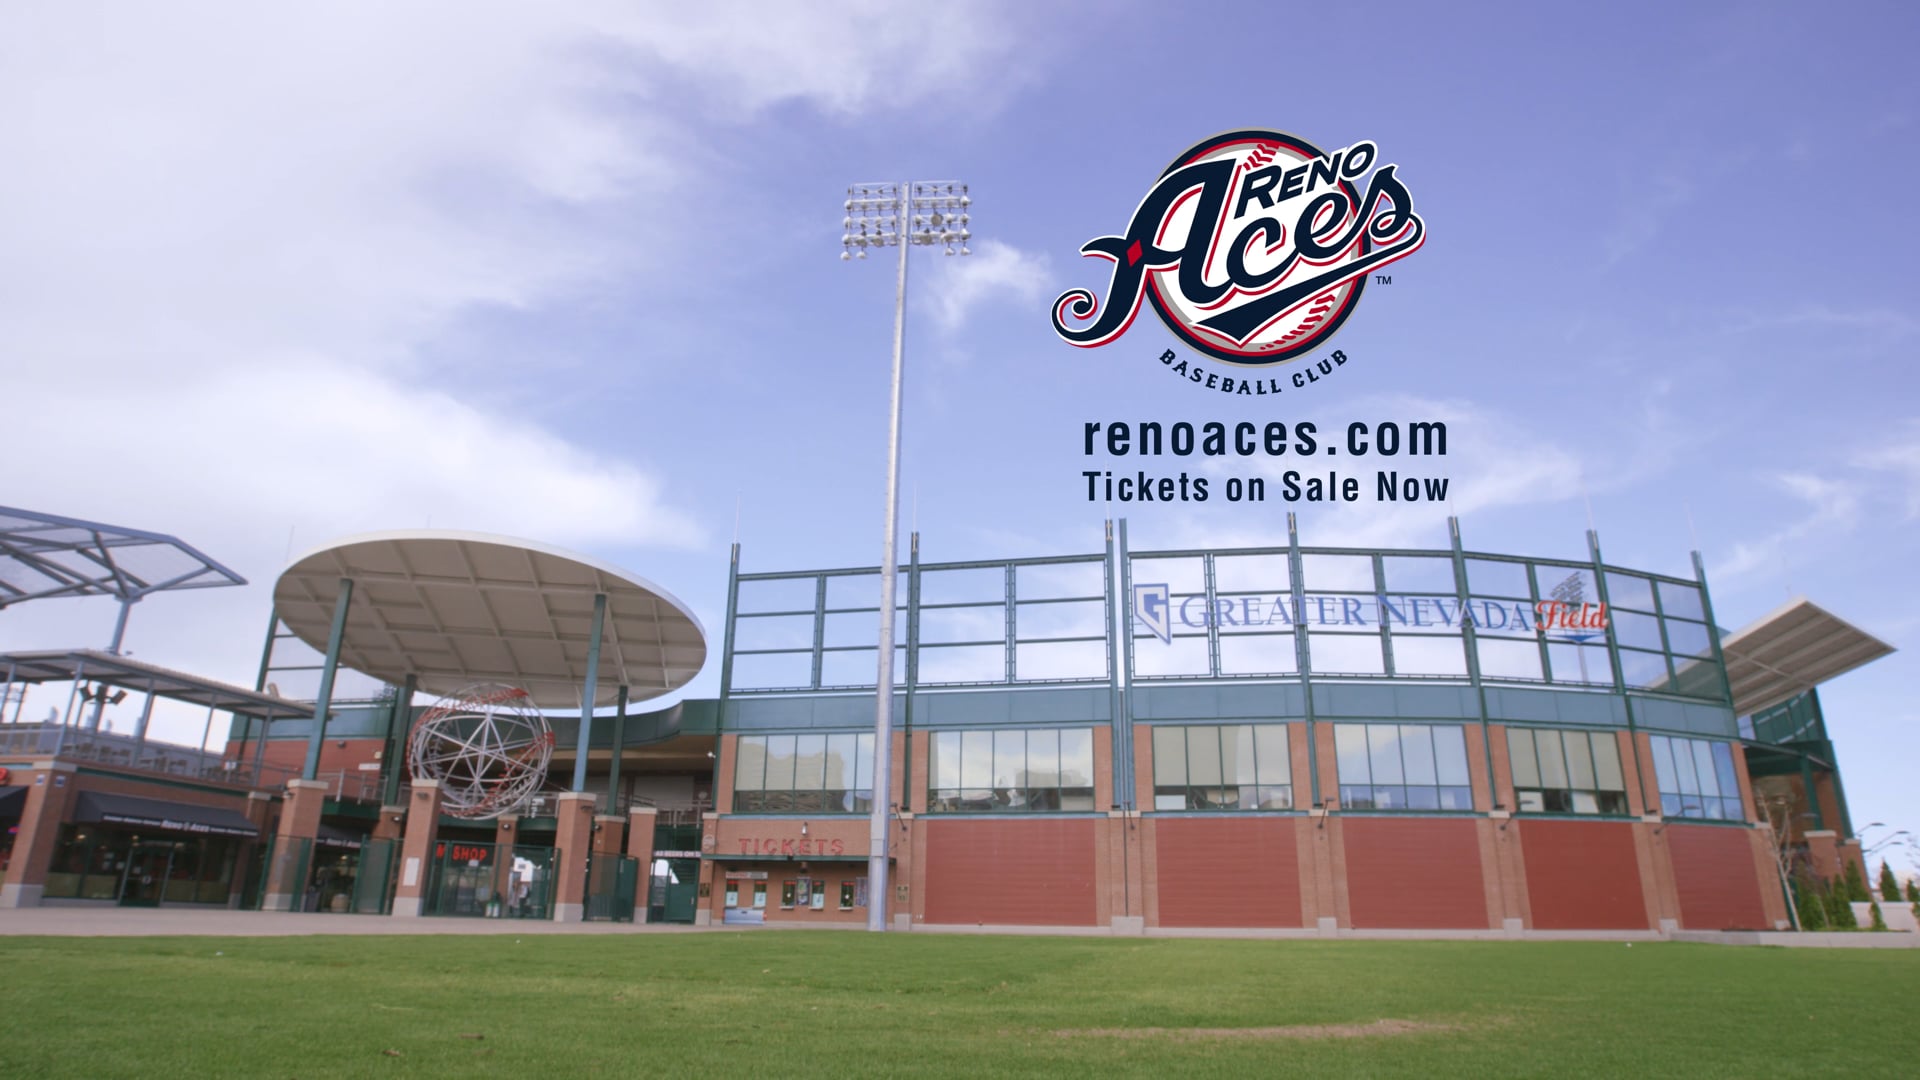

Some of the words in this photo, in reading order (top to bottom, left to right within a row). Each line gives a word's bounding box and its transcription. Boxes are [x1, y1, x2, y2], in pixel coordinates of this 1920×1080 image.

[1179, 594, 1367, 629] GREATER
[1375, 594, 1531, 631] NEVADA
[1535, 599, 1609, 631] Field
[452, 845, 488, 862] SHOP
[738, 838, 845, 856] TICKETS
